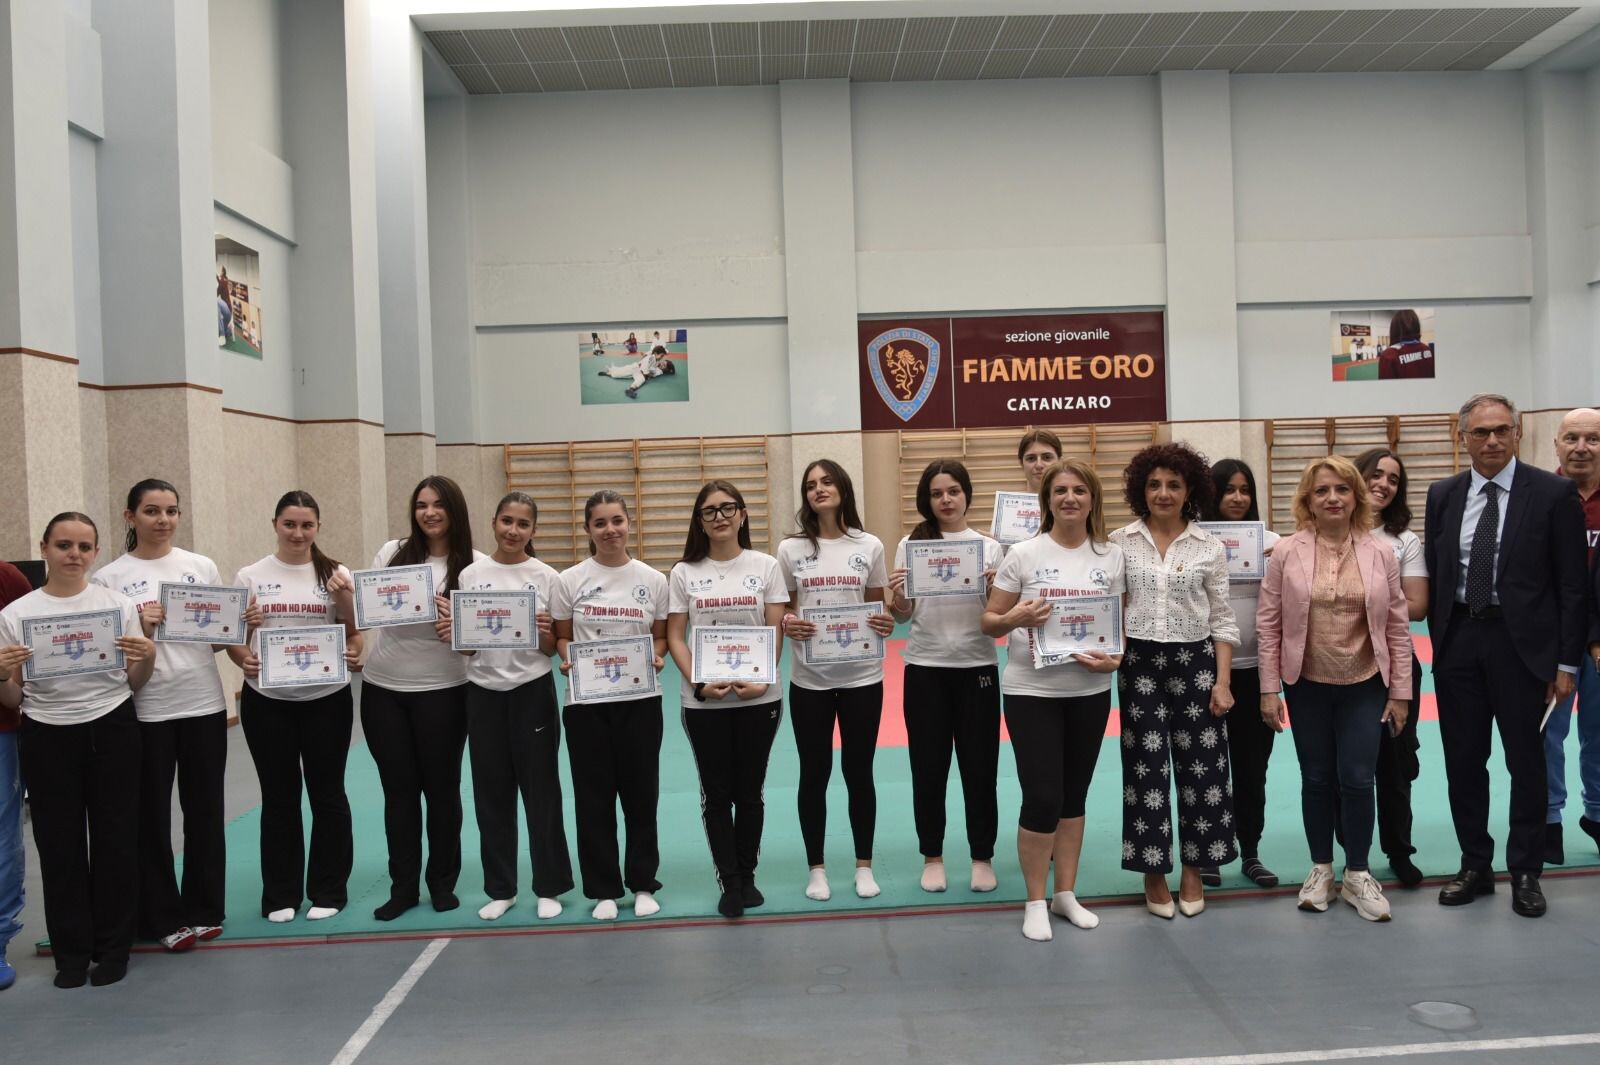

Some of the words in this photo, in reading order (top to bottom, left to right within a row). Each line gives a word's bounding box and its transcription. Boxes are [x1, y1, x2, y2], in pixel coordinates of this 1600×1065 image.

[1005, 330, 1051, 343] sezione
[1054, 328, 1110, 344] giovanile
[963, 356, 1083, 383] FIAMME
[1089, 353, 1155, 380] ORO
[1006, 395, 1112, 411] CATANZARO
[810, 576, 825, 587] NON
[826, 576, 836, 586] HO
[837, 576, 861, 586] PAURA
[1039, 587, 1048, 597] IO
[1049, 588, 1067, 598] NON
[262, 604, 270, 614] IO
[270, 603, 288, 613] NON
[288, 603, 300, 613] HO
[301, 603, 327, 614] PAURA
[696, 599, 703, 609] IO
[704, 598, 720, 608] NON
[720, 597, 731, 607] HO
[732, 596, 757, 606] PAURA
[591, 606, 607, 616] NON
[608, 607, 619, 617] HO
[619, 607, 644, 618] PAURA
